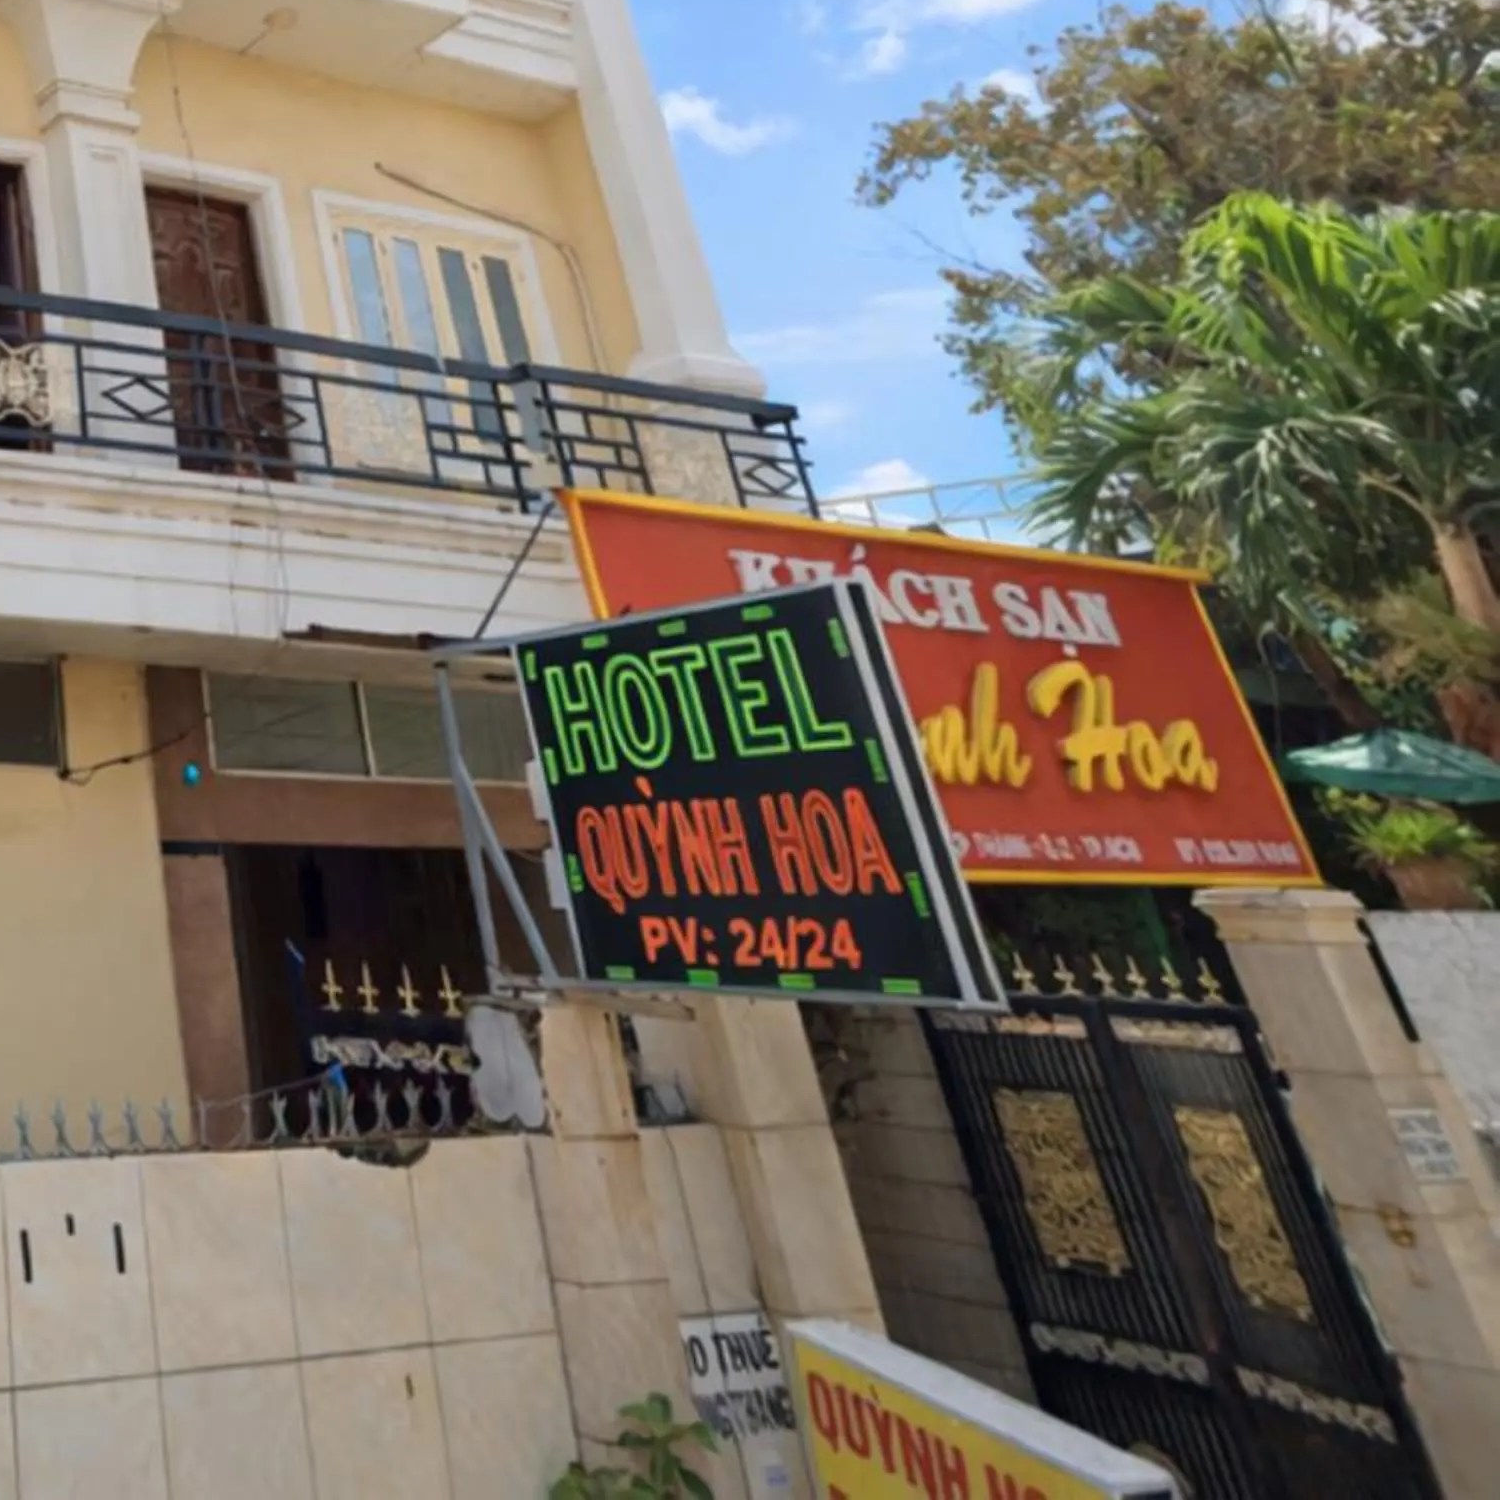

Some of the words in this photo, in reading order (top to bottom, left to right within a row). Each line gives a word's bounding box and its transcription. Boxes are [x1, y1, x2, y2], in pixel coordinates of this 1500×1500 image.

[993, 581, 1123, 657] SẠN
[543, 628, 853, 775] HOTEL
[1027, 660, 1218, 792] Hoa
[576, 776, 761, 915] QUỲNH
[759, 787, 904, 896] HOA
[640, 916, 720, 967] PV:
[728, 915, 863, 970] 24/24
[806, 1370, 970, 1500] QUỲNH
